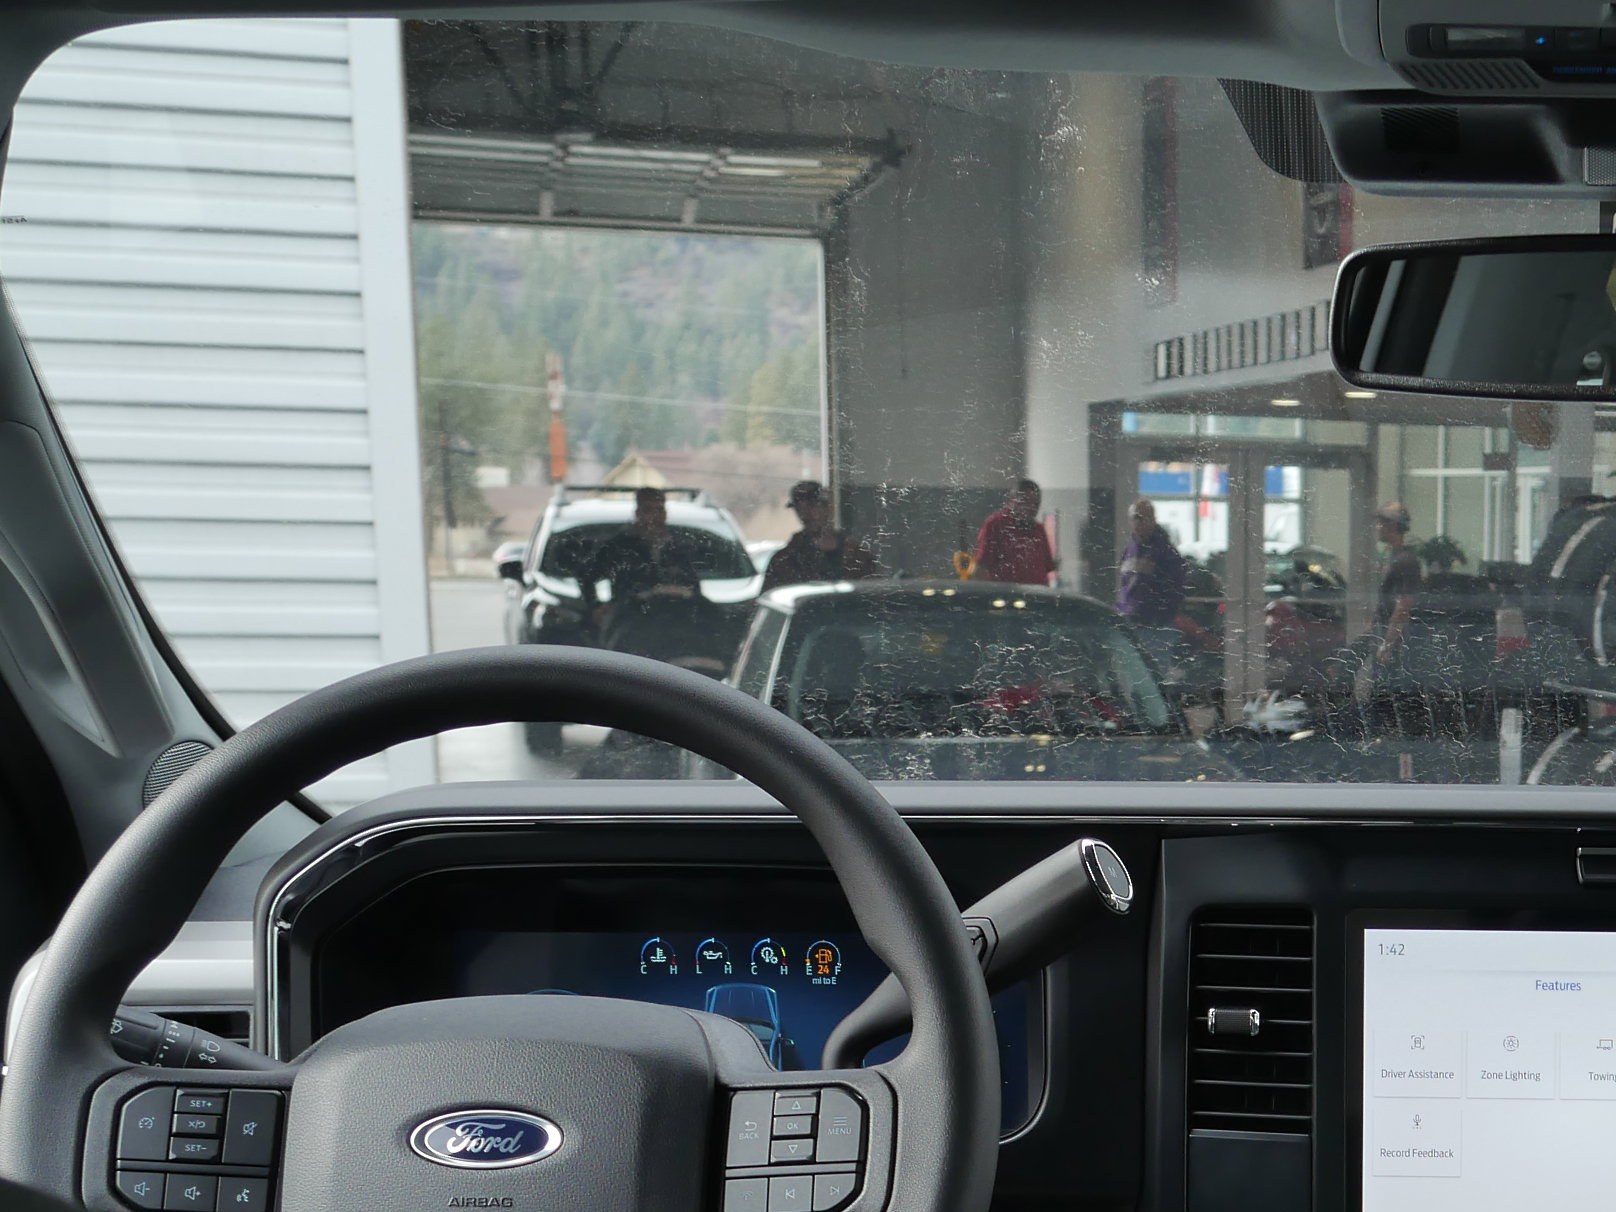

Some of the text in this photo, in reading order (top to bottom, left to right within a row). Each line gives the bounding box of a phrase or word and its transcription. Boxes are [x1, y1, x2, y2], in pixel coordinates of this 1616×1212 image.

[1378, 944, 1405, 956] 1:42
[640, 965, 647, 975] C
[670, 965, 677, 974] H
[696, 965, 702, 974] L
[724, 965, 732, 974] H
[751, 965, 758, 975] C
[780, 965, 788, 975] H
[806, 966, 813, 976] E
[817, 965, 830, 974] 24
[834, 966, 841, 975] F
[1535, 980, 1581, 991] Features
[1381, 1069, 1454, 1079] Driver Assistance
[1481, 1070, 1541, 1082] Zone Lighting
[787, 1122, 799, 1130] OK
[446, 1122, 524, 1154] Ford
[1380, 1148, 1454, 1158] Record Feedback
[448, 1197, 513, 1208] AIRBAG
